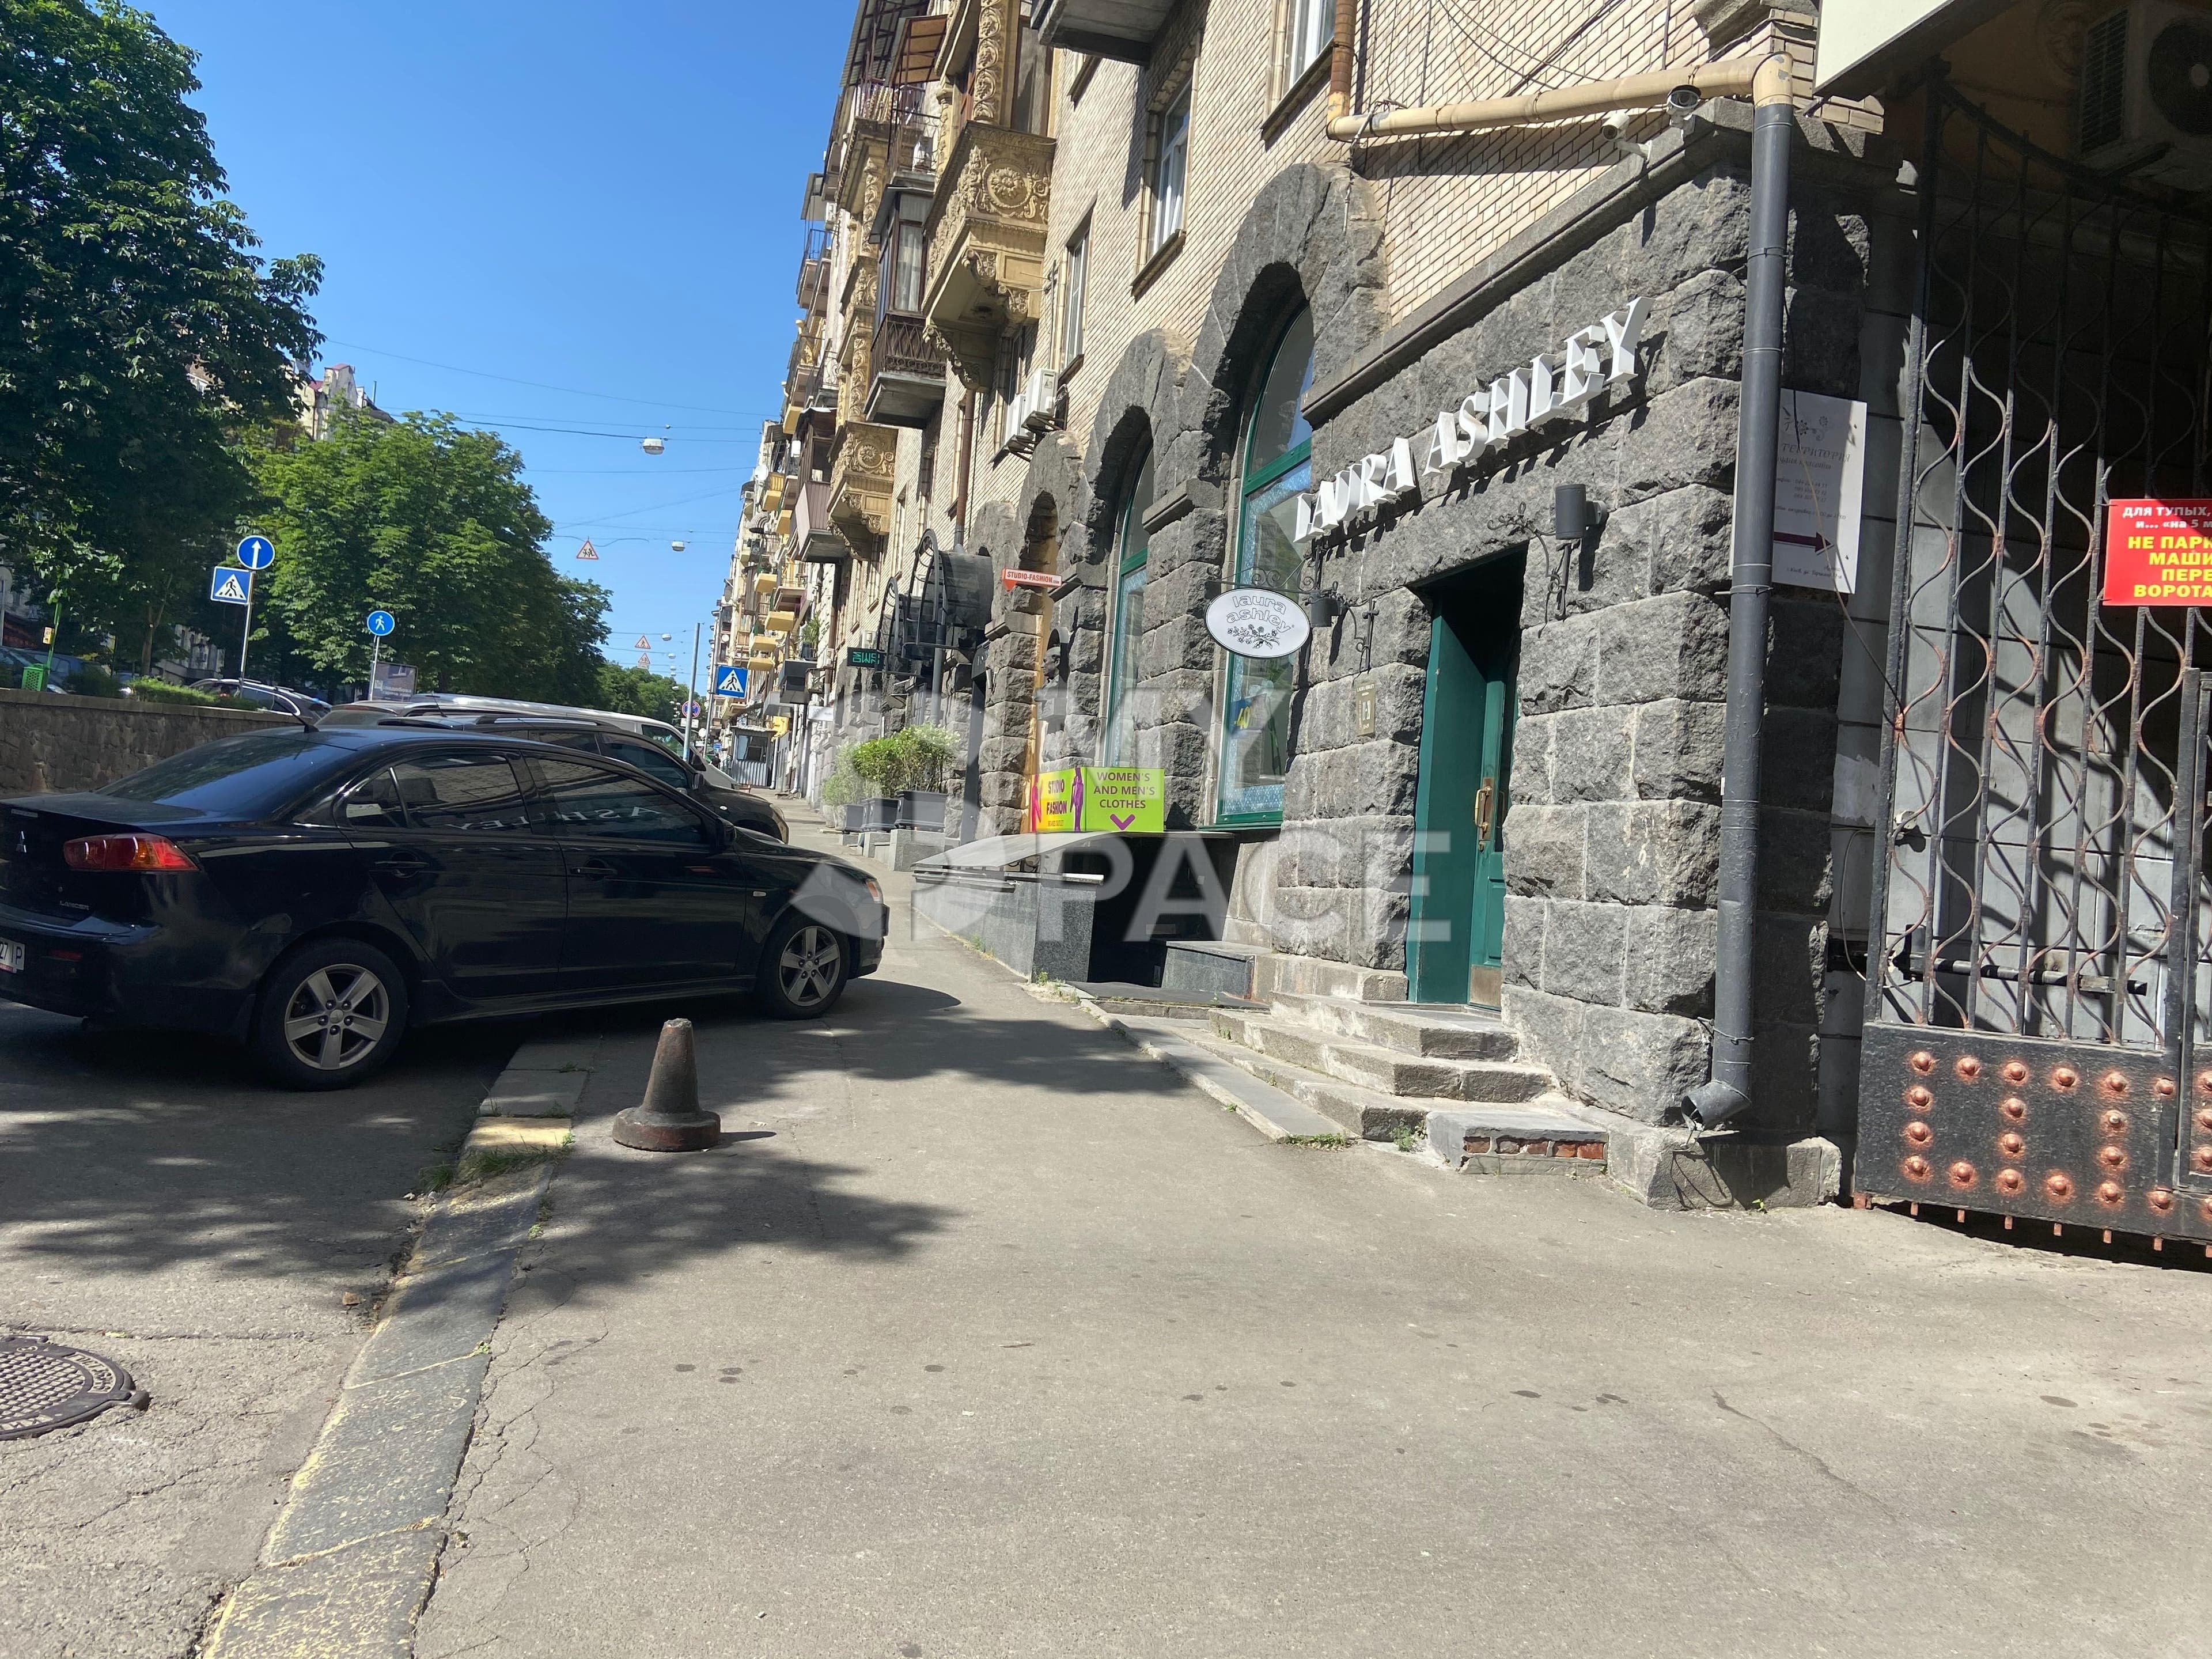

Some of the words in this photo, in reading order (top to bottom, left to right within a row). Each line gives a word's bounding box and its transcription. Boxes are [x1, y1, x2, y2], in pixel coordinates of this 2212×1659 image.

[1293, 437, 1416, 543] LAURA
[1422, 296, 1655, 477] ASHLEY
[2122, 506, 2153, 518] ДЛЯ
[2156, 506, 2211, 517] ТУПЫХ,
[2191, 519, 2199, 528] 5
[2128, 536, 2154, 550] НЕ
[2161, 569, 2212, 582] ПЕРЕ
[1232, 595, 1286, 615] laura
[1226, 608, 1291, 633] ashley
[1097, 772, 1150, 782] WOMEN'S
[1048, 779, 1065, 794] STUDIO
[1093, 785, 1118, 795] AND
[1121, 786, 1155, 796] MEN'S
[1046, 800, 1067, 816] FASHION
[1100, 799, 1146, 809] CLOTHES
[59, 900, 89, 911] LANCER
